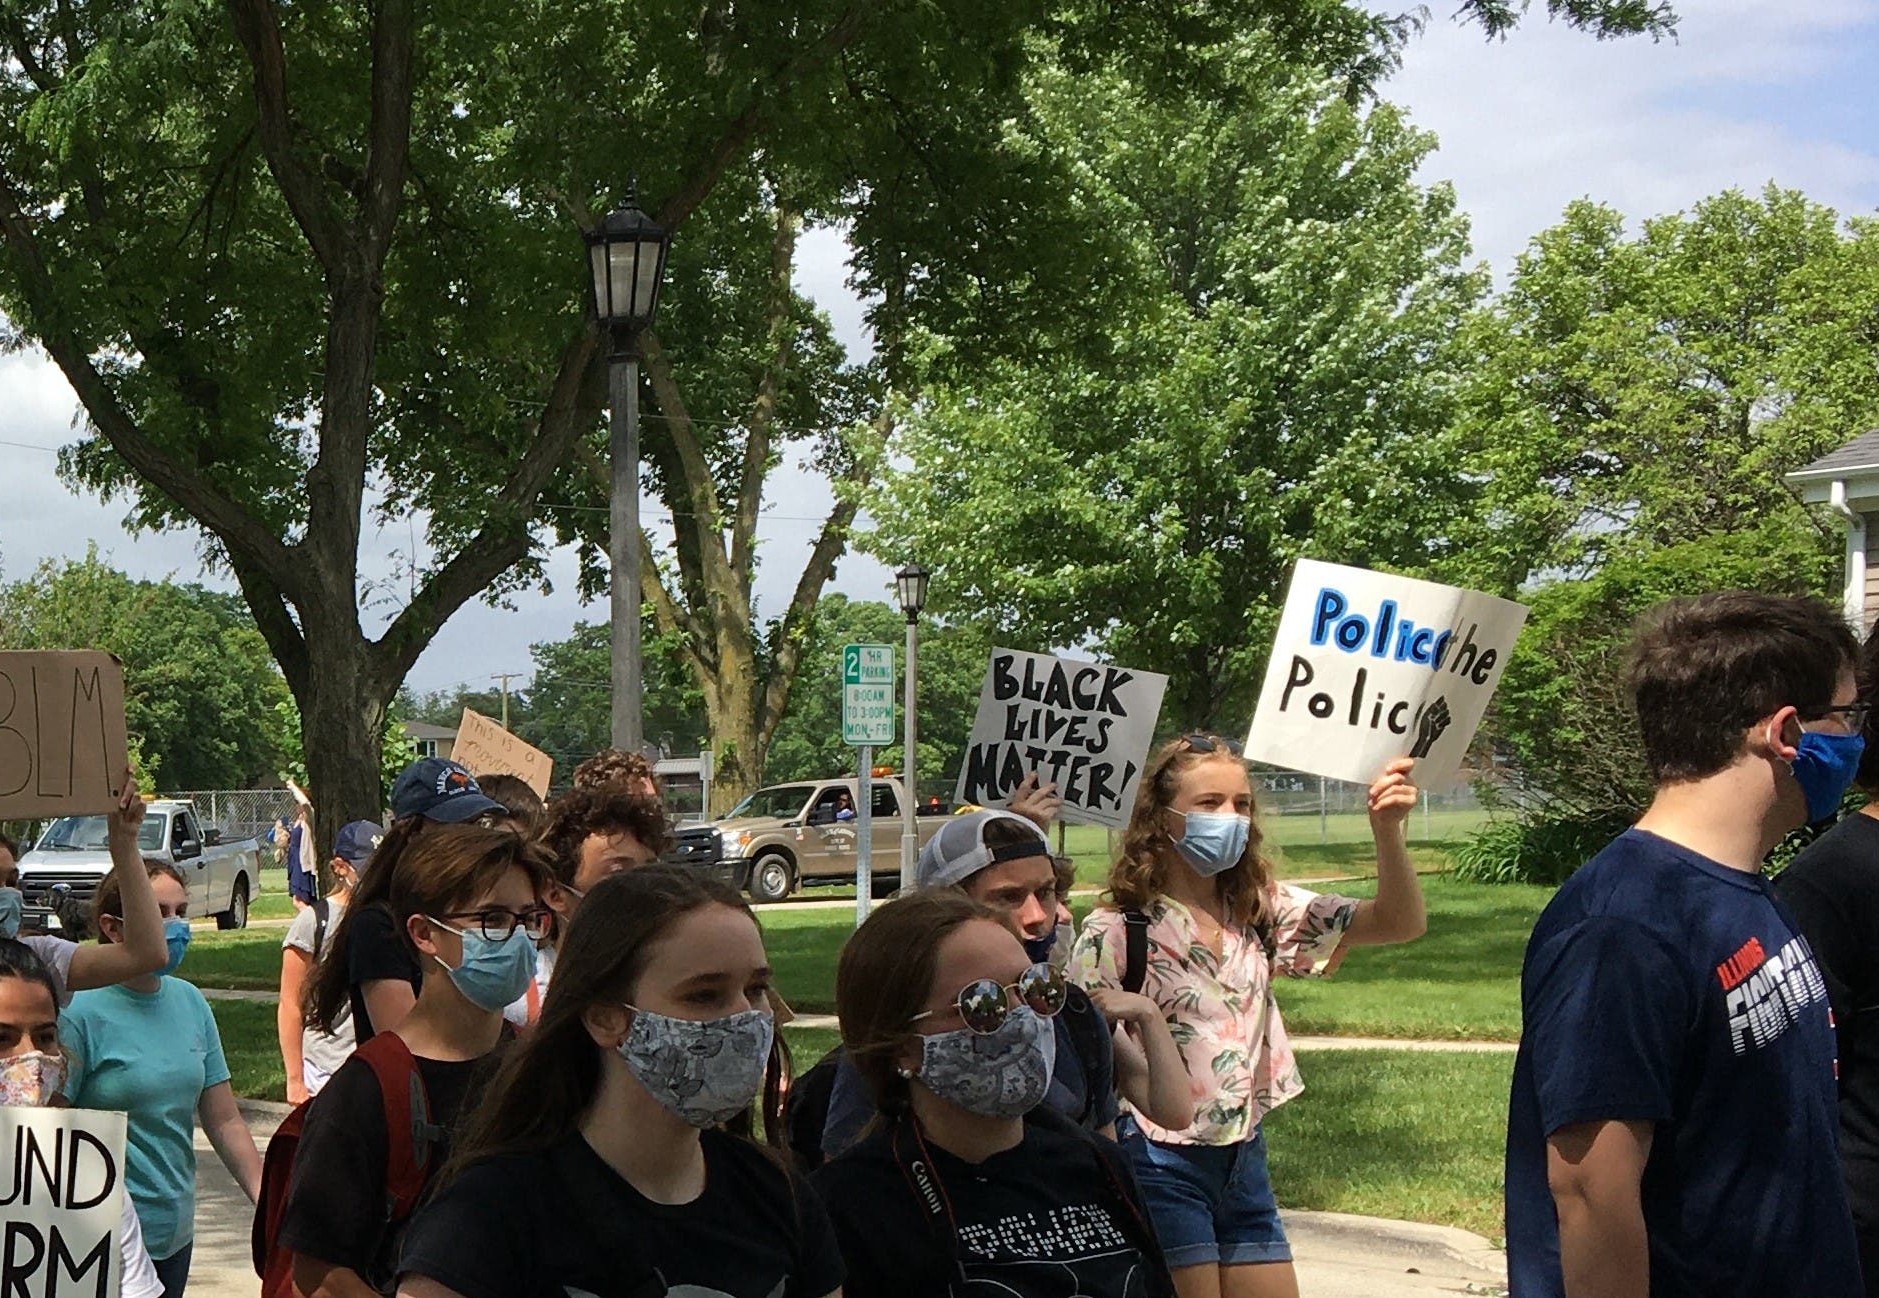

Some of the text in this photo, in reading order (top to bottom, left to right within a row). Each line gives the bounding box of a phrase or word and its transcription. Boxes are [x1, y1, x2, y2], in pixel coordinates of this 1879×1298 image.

[847, 652, 858, 677] 2
[862, 666, 890, 678] PARKING
[869, 651, 882, 662] HR
[993, 654, 1134, 717] BLACK
[1279, 653, 1426, 736] Polic
[847, 707, 892, 718] TO 3:00PM
[1004, 703, 1114, 754] LIVES
[963, 742, 1137, 811] MATTER!
[1715, 936, 1767, 991] ILLINOIS
[912, 1160, 942, 1214] Canon
